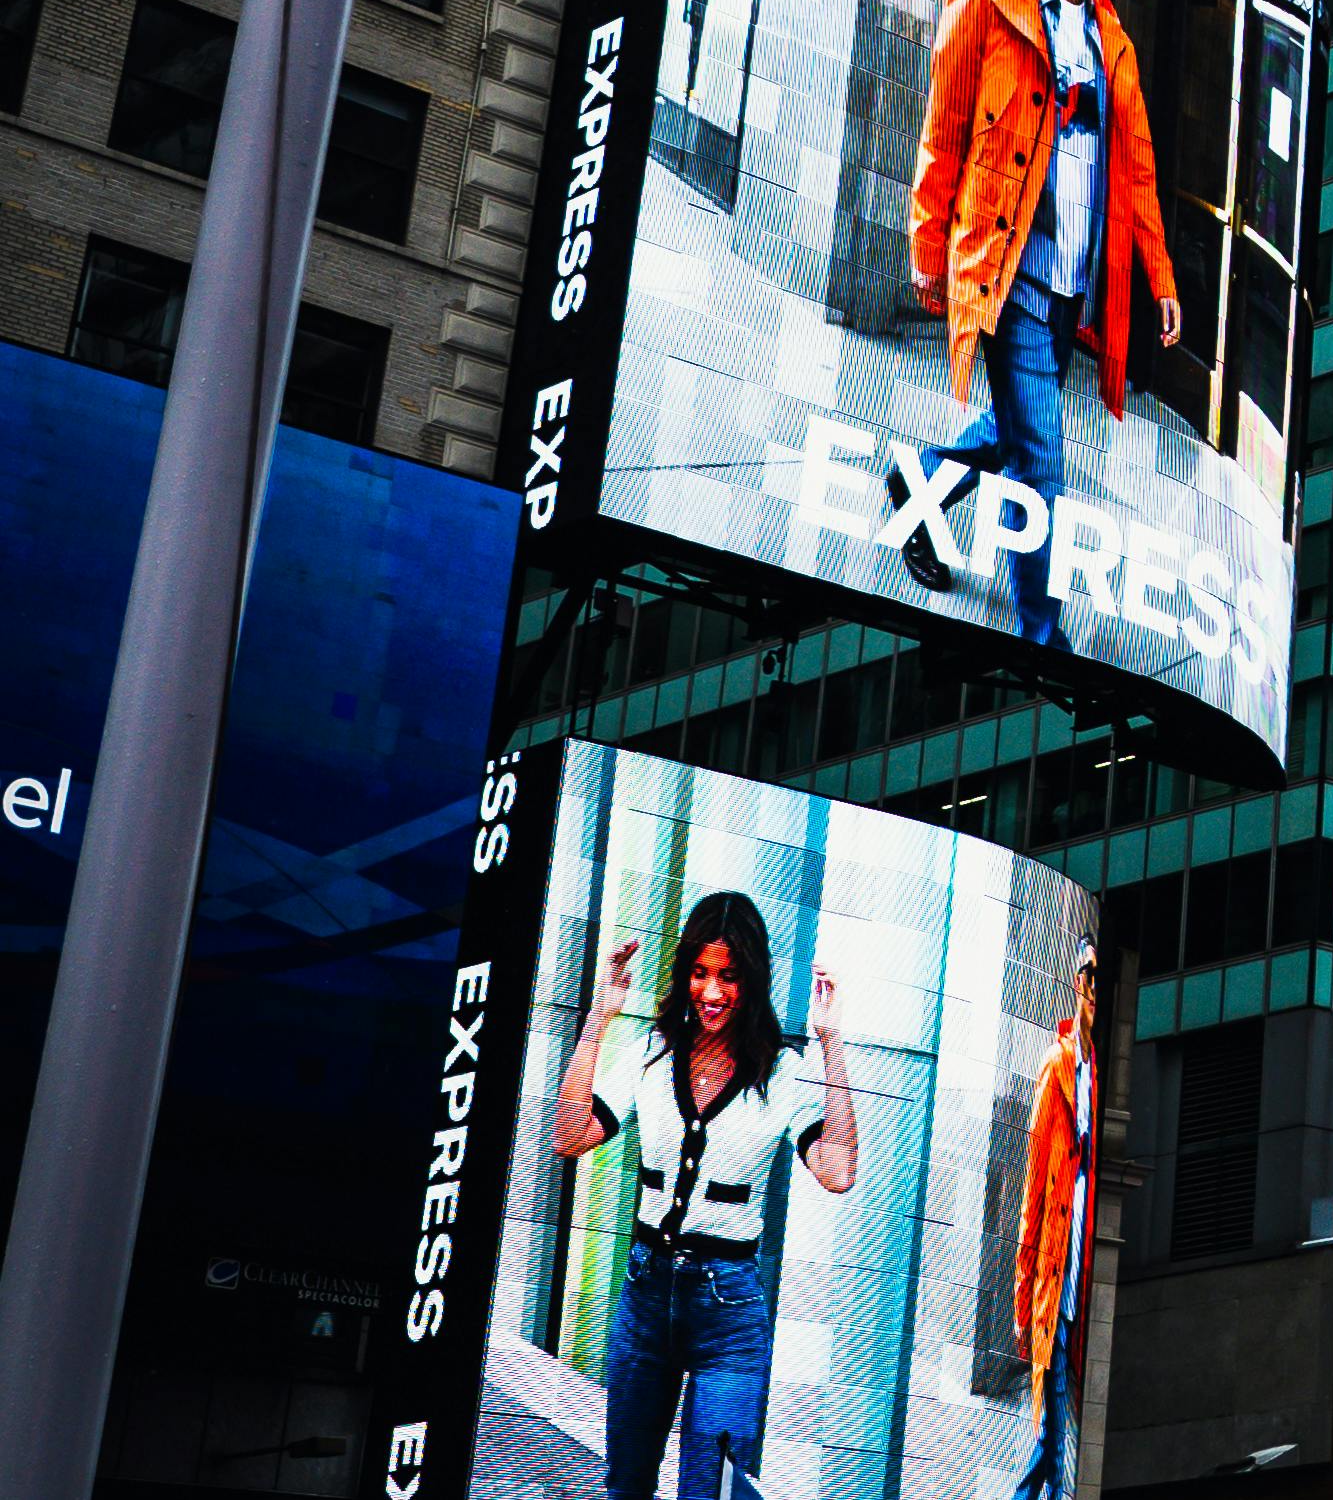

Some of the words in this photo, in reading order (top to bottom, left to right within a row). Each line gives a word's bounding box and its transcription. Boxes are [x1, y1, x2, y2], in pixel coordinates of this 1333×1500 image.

[551, 16, 625, 323] EXPRESS
[798, 413, 1268, 685] EXPRESS
[405, 960, 492, 1344] EXPRESS
[297, 1289, 381, 1309] SPECTACOLOR
